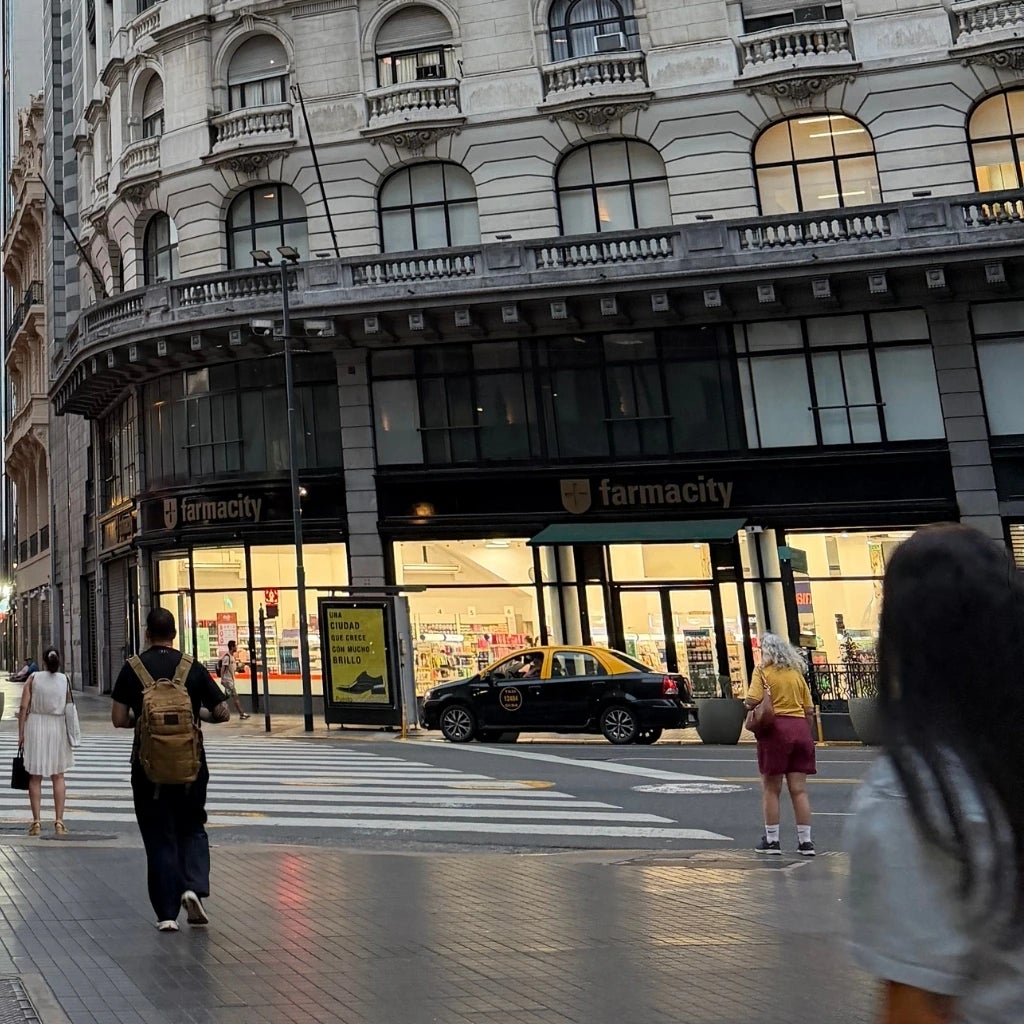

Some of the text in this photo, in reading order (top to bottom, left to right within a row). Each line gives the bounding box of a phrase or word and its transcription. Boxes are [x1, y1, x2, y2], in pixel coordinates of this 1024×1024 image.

[599, 475, 733, 509] farmacity
[180, 493, 262, 523] farmacity
[329, 611, 342, 619] UNA
[330, 621, 360, 630] CIUDAD
[331, 634, 367, 642] QUE CRECE
[332, 656, 362, 664] BRILLO
